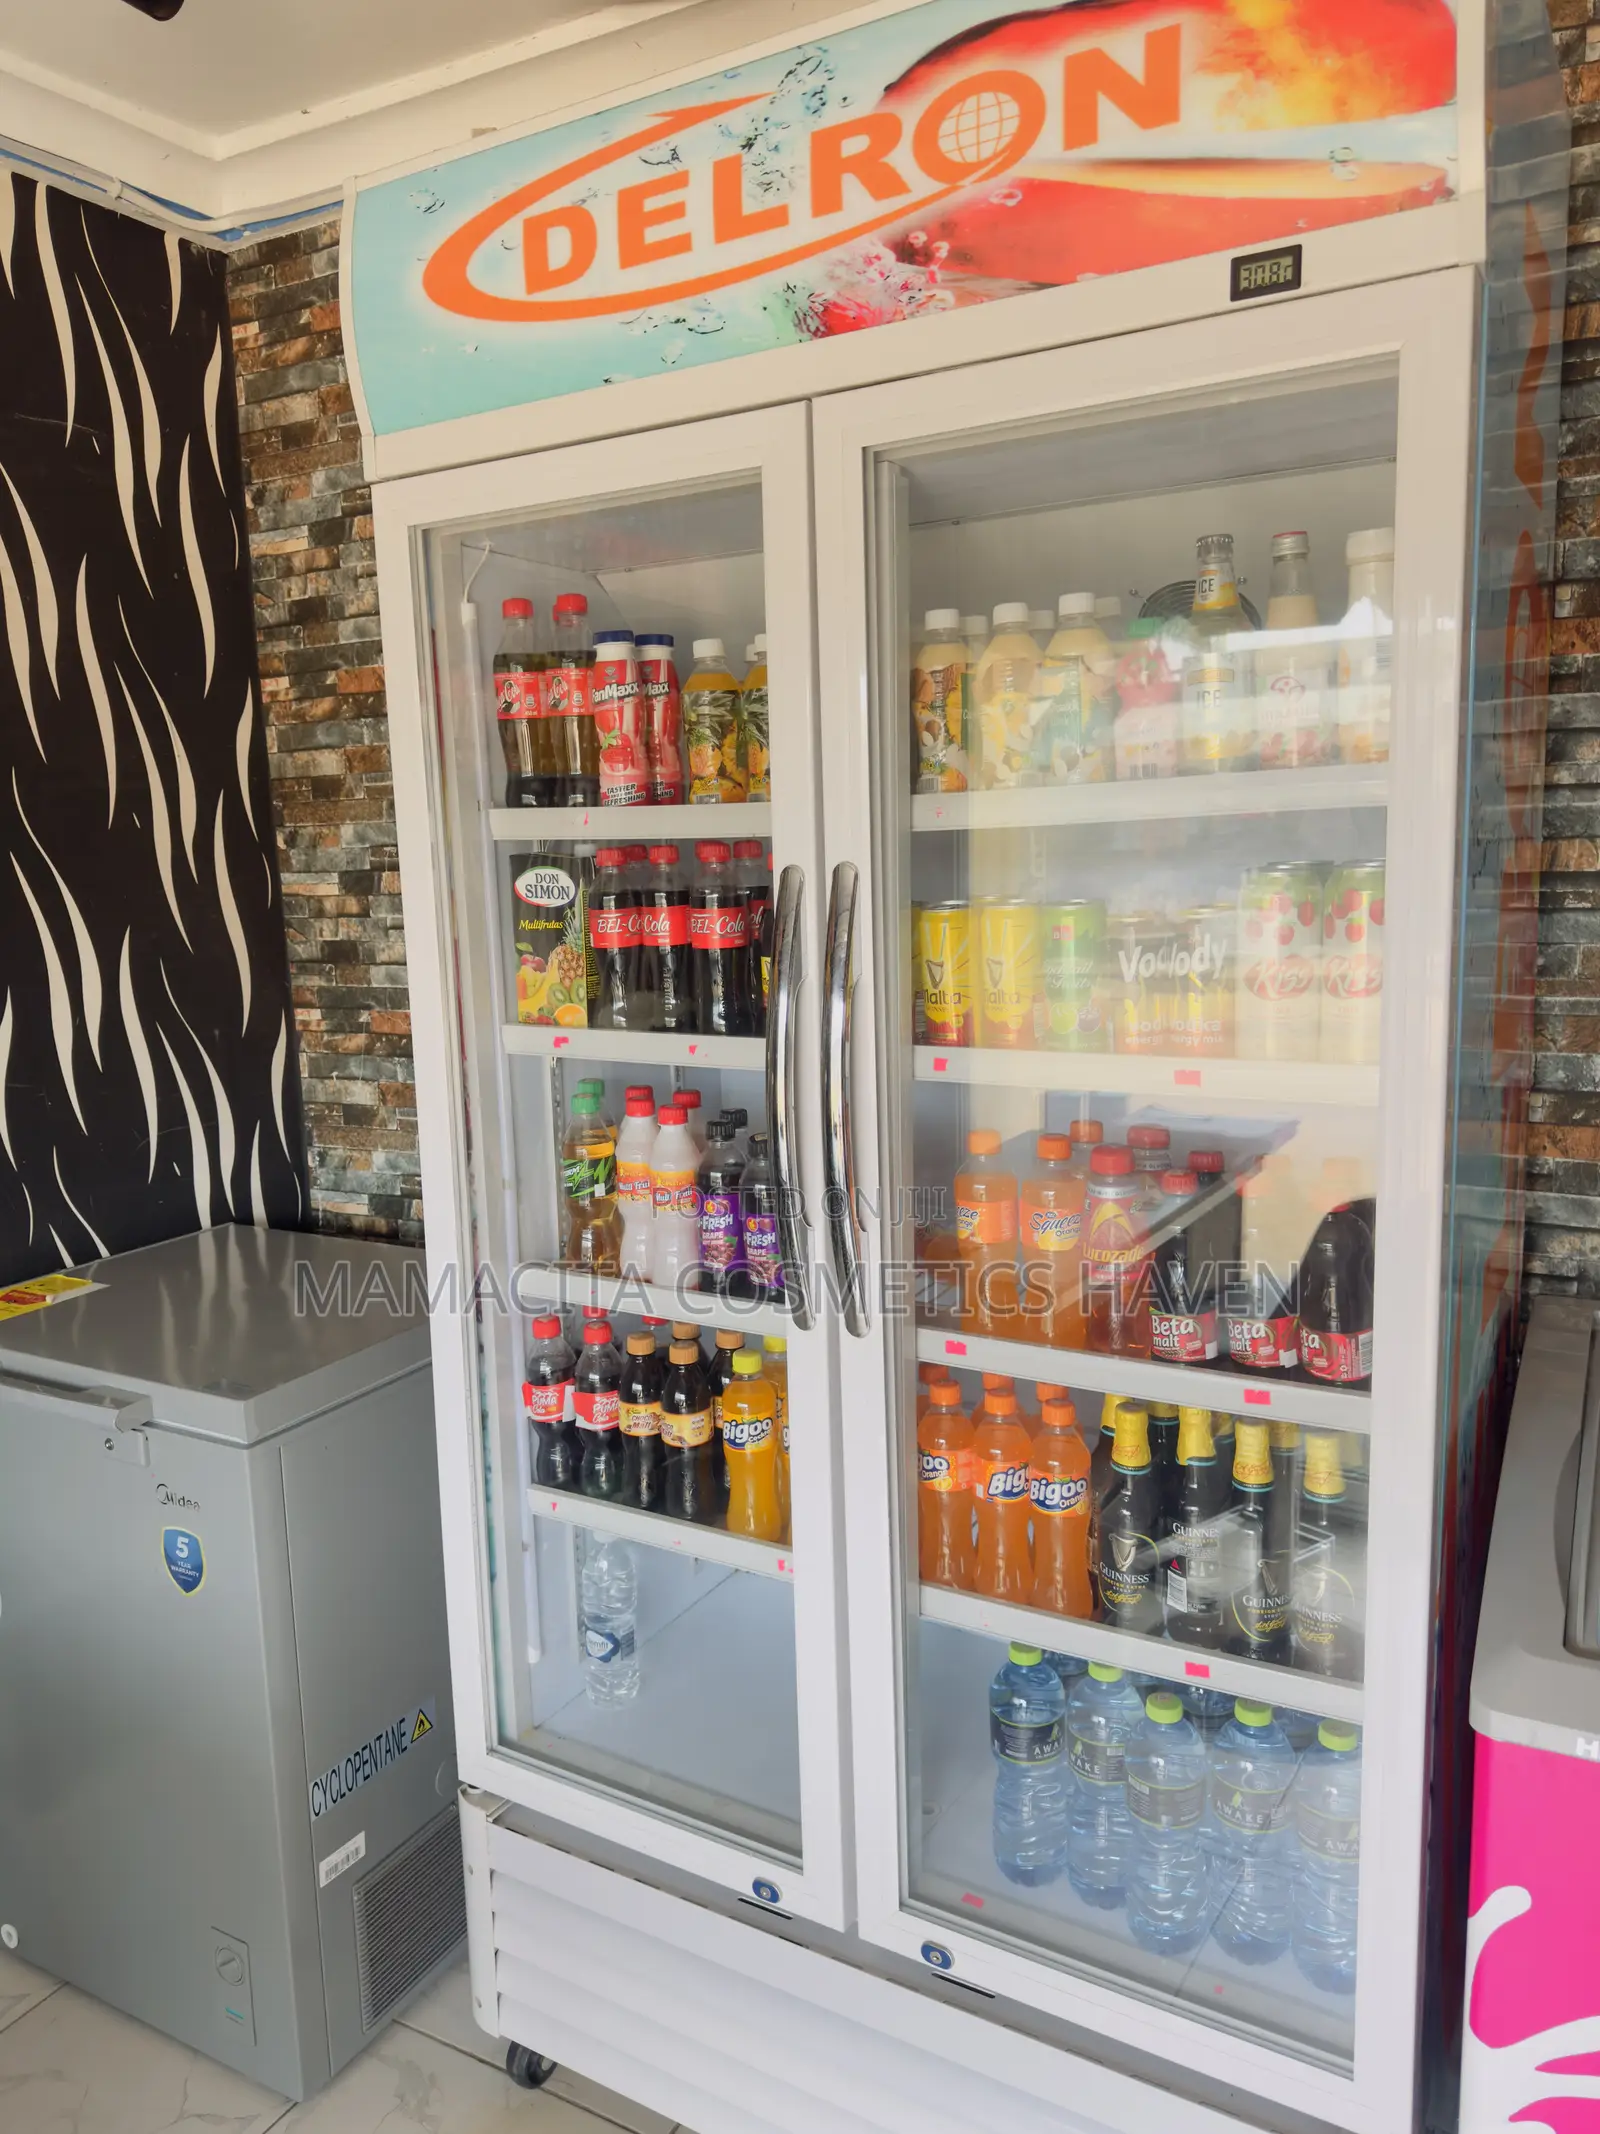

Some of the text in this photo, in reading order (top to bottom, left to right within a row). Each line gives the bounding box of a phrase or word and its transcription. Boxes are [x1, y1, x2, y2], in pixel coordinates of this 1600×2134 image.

[523, 23, 1181, 296] DELRON
[1197, 578, 1215, 595] ICE
[534, 872, 560, 885] DON
[524, 883, 571, 901] SIMON
[518, 918, 565, 932] Multifrutas
[1252, 958, 1309, 999] Kiss
[957, 1204, 979, 1220] eze
[702, 1231, 724, 1240] GRAPE
[1151, 1314, 1195, 1337] Beta
[1228, 1317, 1266, 1339] Beta
[1152, 1332, 1181, 1349] malt
[1229, 1336, 1253, 1351] malt
[723, 1417, 773, 1444] Bigoo
[921, 1469, 949, 1479] Orange
[156, 1483, 201, 1512] Midea
[1029, 1479, 1088, 1506] Bigoo
[1059, 1491, 1087, 1508] Orange
[175, 1536, 190, 1559] 5
[171, 1564, 200, 1578] WARRANTY
[1099, 1561, 1150, 1585] GUINNESS
[310, 1717, 408, 1818] CYCLOPENTANE
[1215, 1799, 1264, 1825] AWAKE
